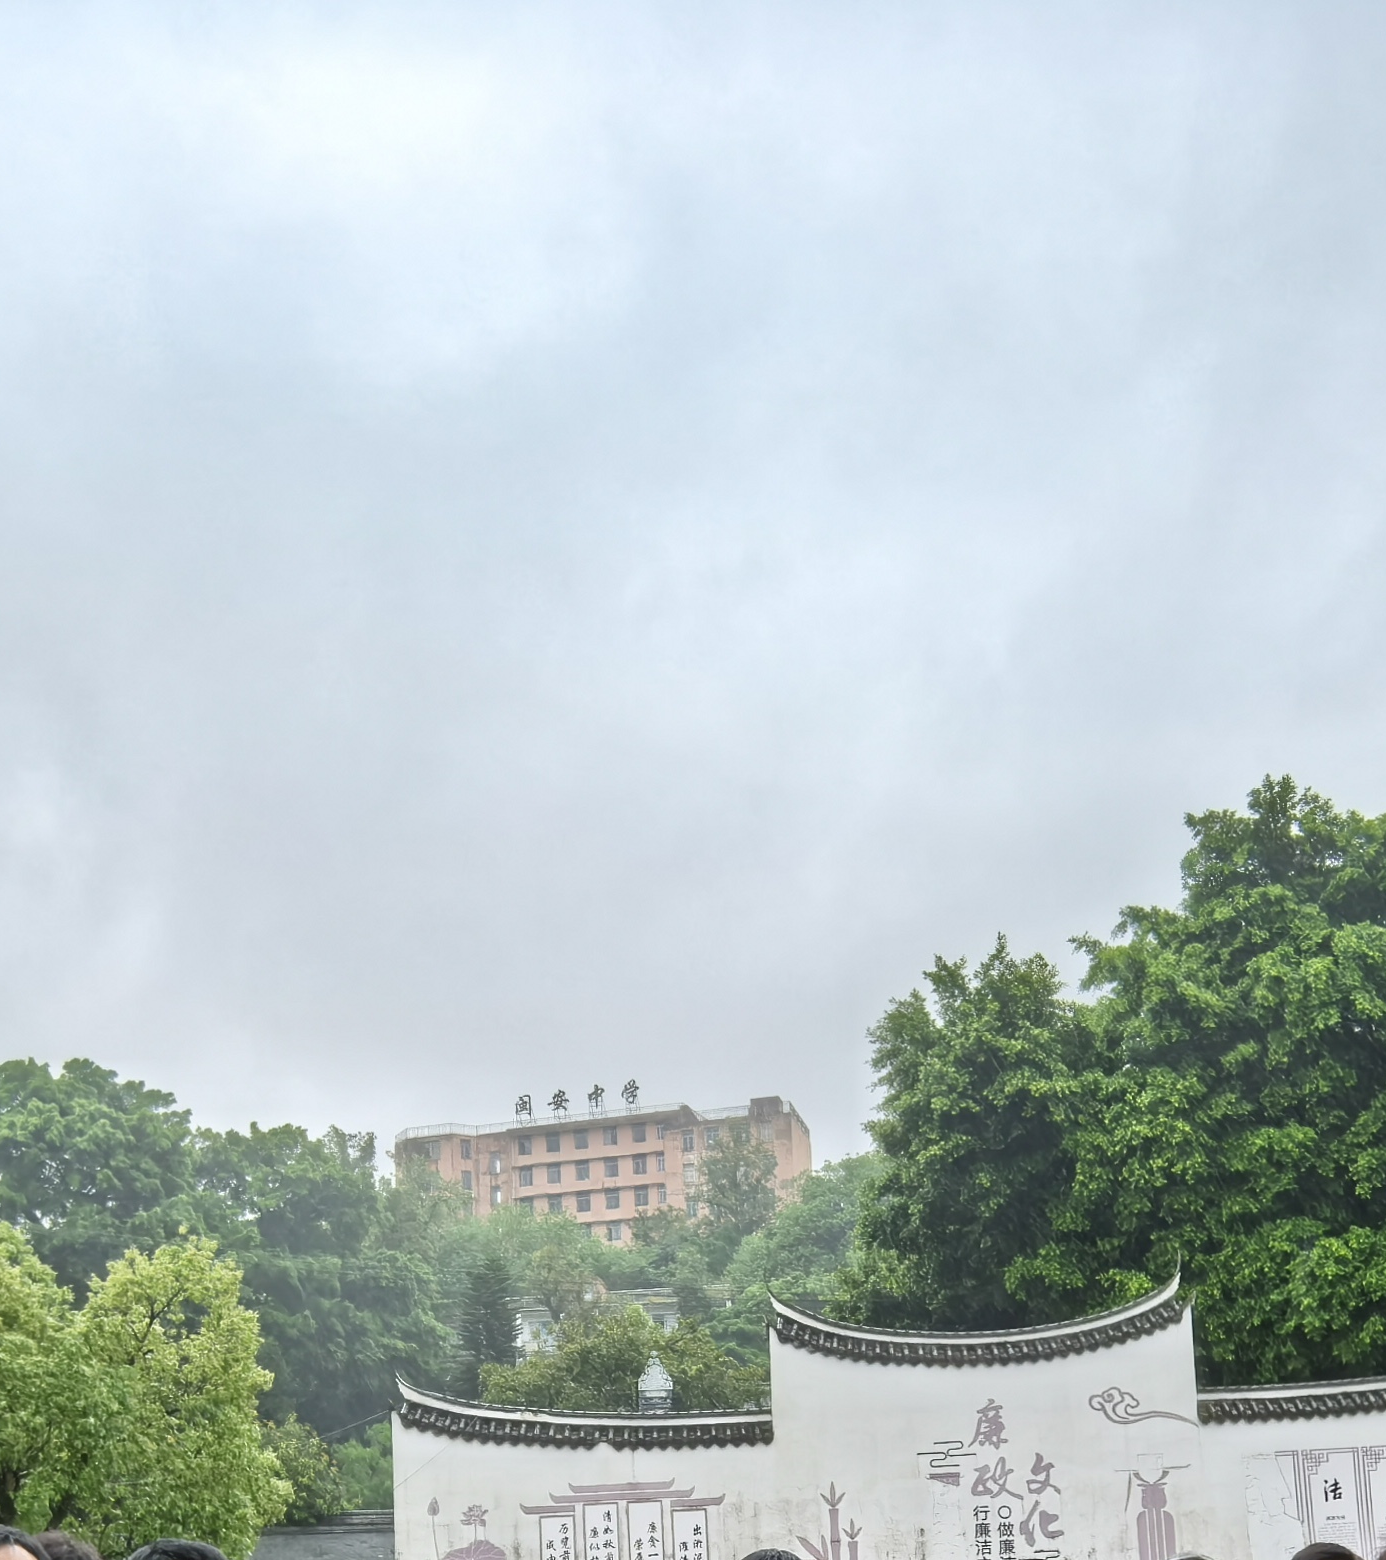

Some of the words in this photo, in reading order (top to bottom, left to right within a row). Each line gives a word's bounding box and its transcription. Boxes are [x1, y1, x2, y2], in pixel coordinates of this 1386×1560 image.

[515, 1079, 639, 1119] 闽安中学
[968, 1399, 1024, 1500] 廉政
[1019, 1452, 1064, 1547] 文化
